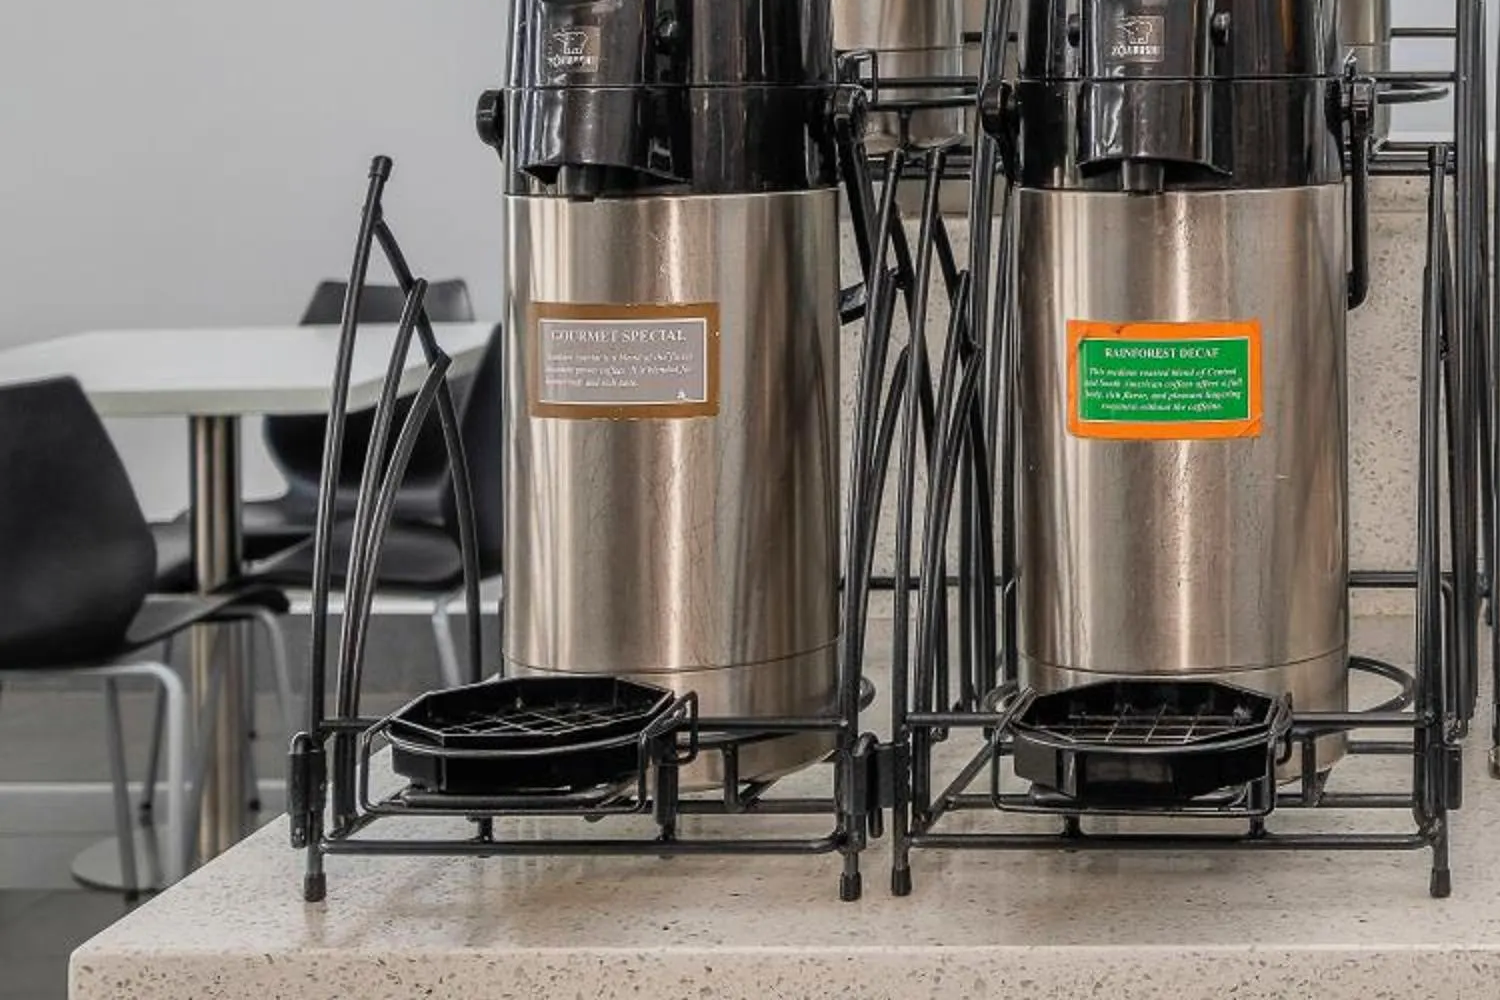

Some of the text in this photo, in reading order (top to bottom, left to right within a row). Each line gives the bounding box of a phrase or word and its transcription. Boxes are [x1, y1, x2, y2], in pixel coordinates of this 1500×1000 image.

[551, 328, 687, 343] GOURMET SPECIAL
[1105, 347, 1221, 359] RAINFOREST DECAF
